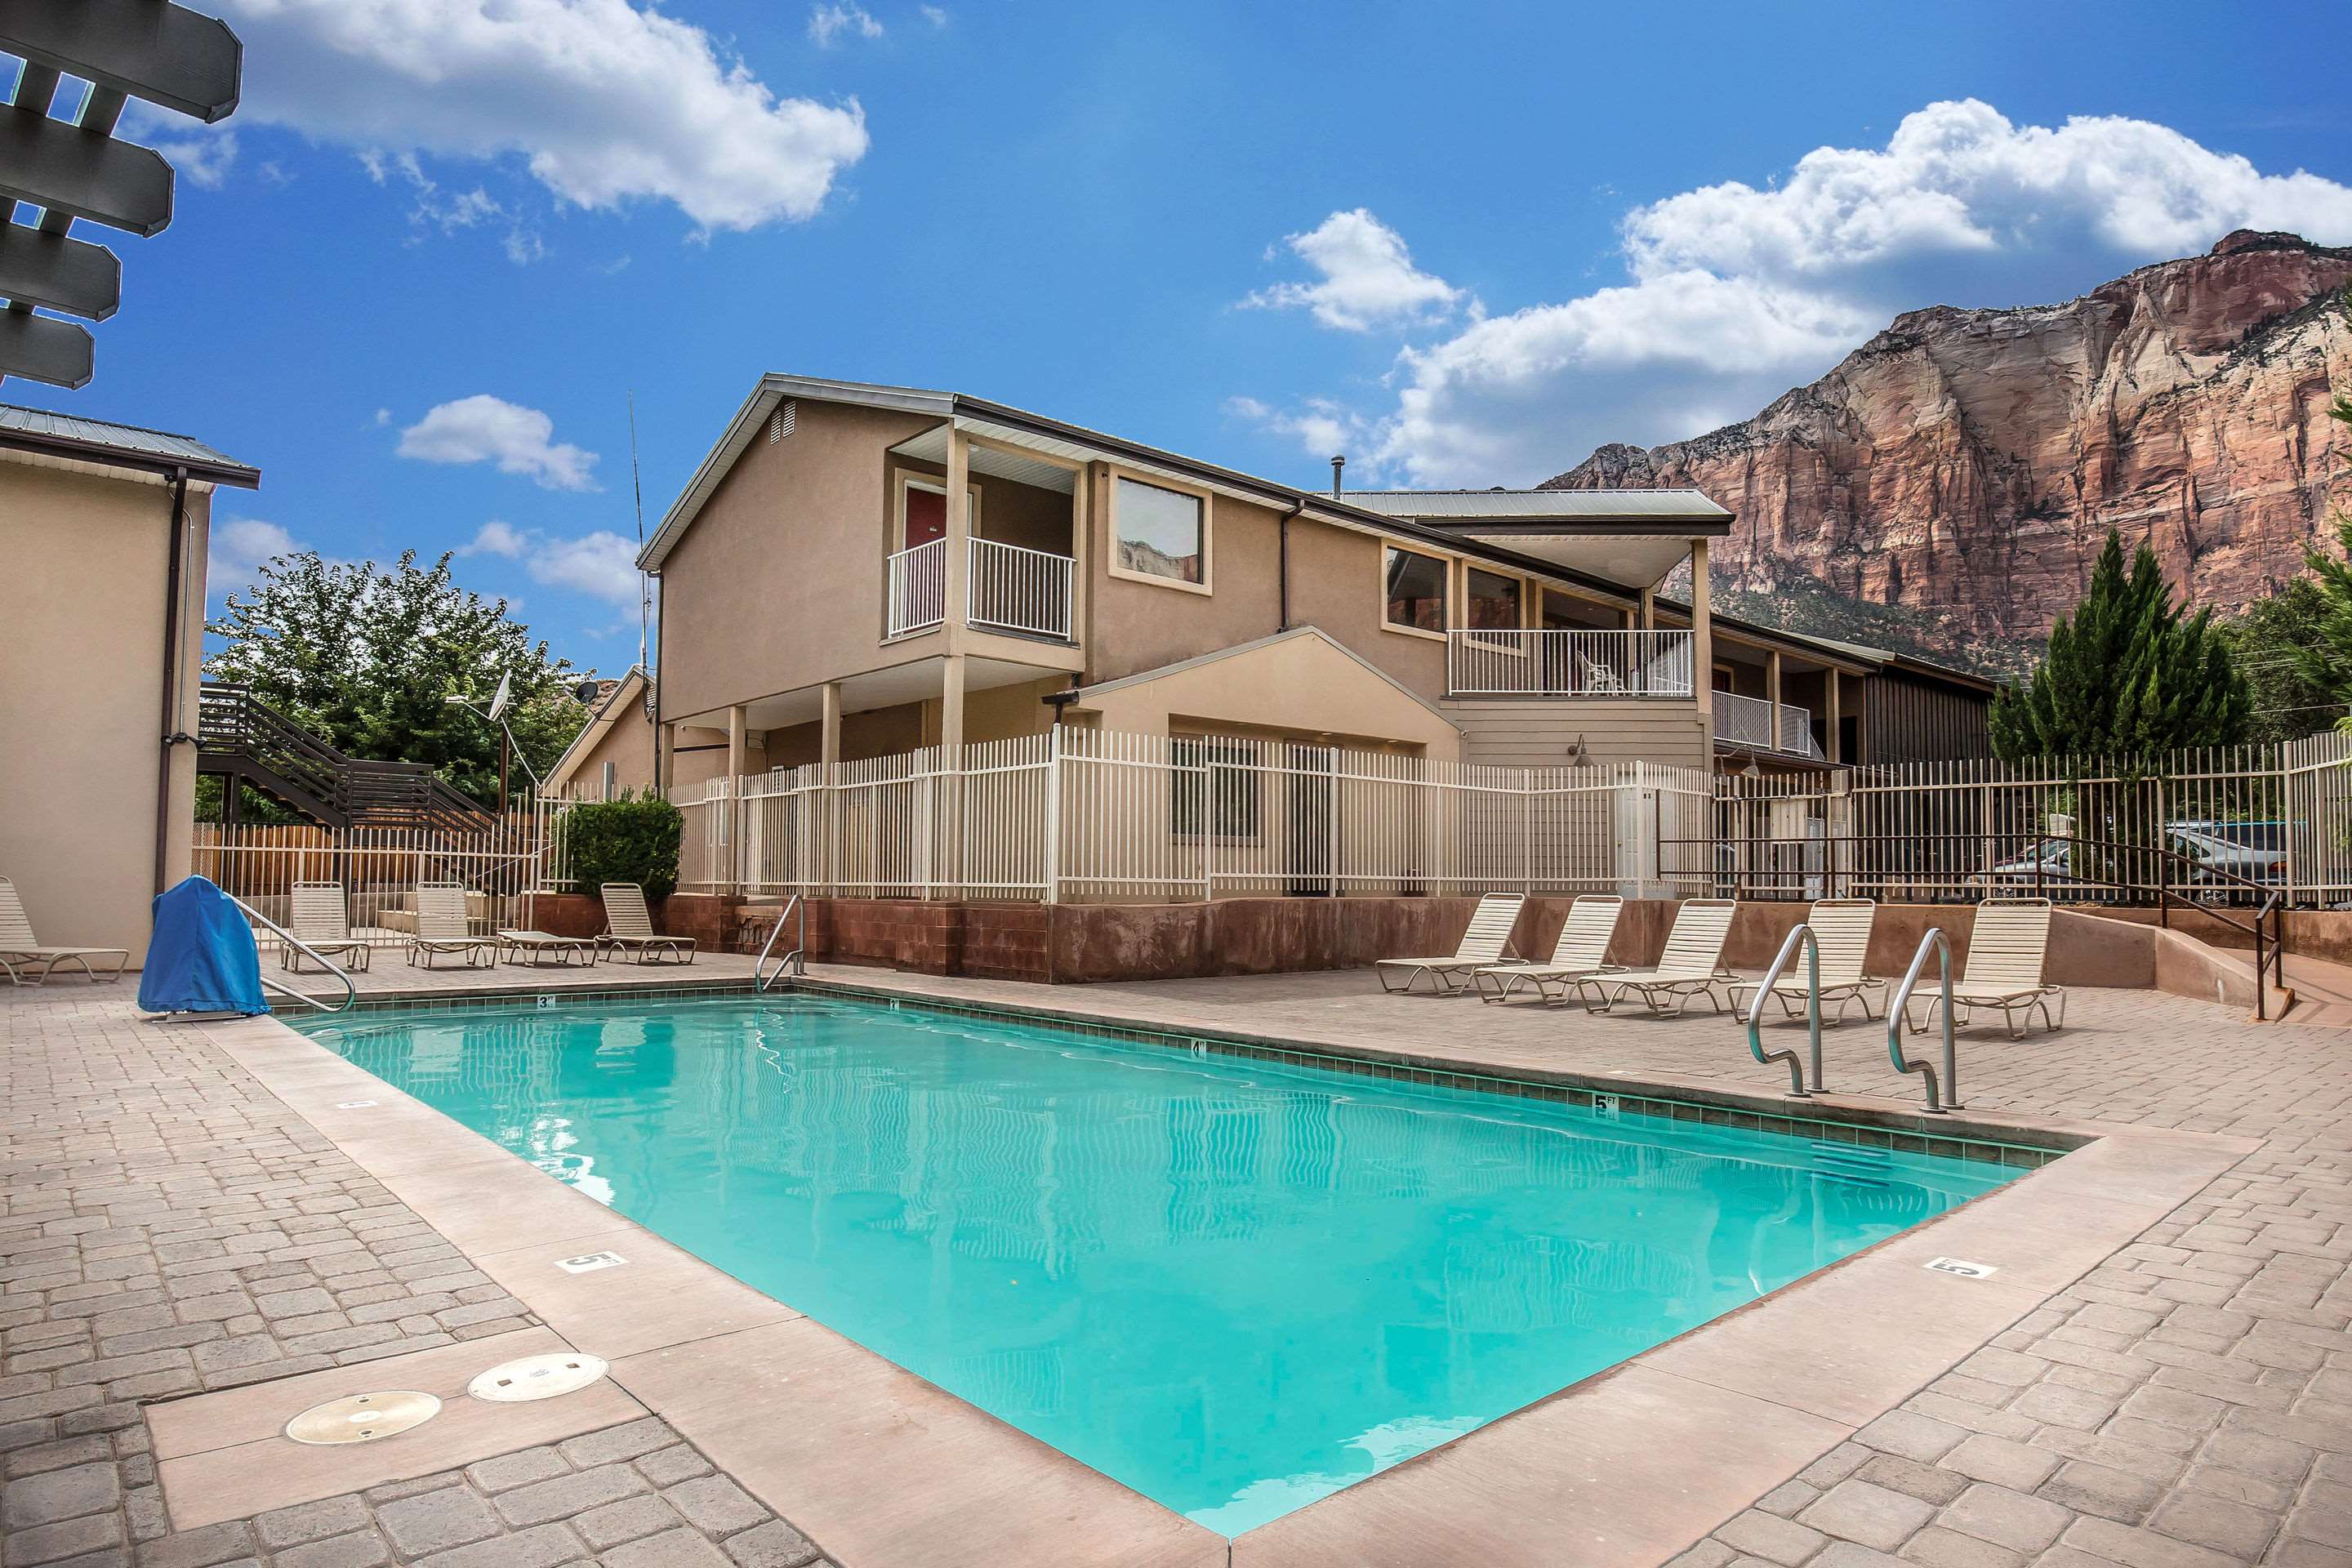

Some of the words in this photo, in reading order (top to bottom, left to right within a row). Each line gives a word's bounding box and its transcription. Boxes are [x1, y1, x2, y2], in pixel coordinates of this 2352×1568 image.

[539, 996, 547, 1008] 3
[1595, 1094, 1607, 1109] 5
[1607, 1096, 1616, 1105] FT
[566, 1253, 612, 1266] 5
[1931, 1263, 1980, 1276] 5
